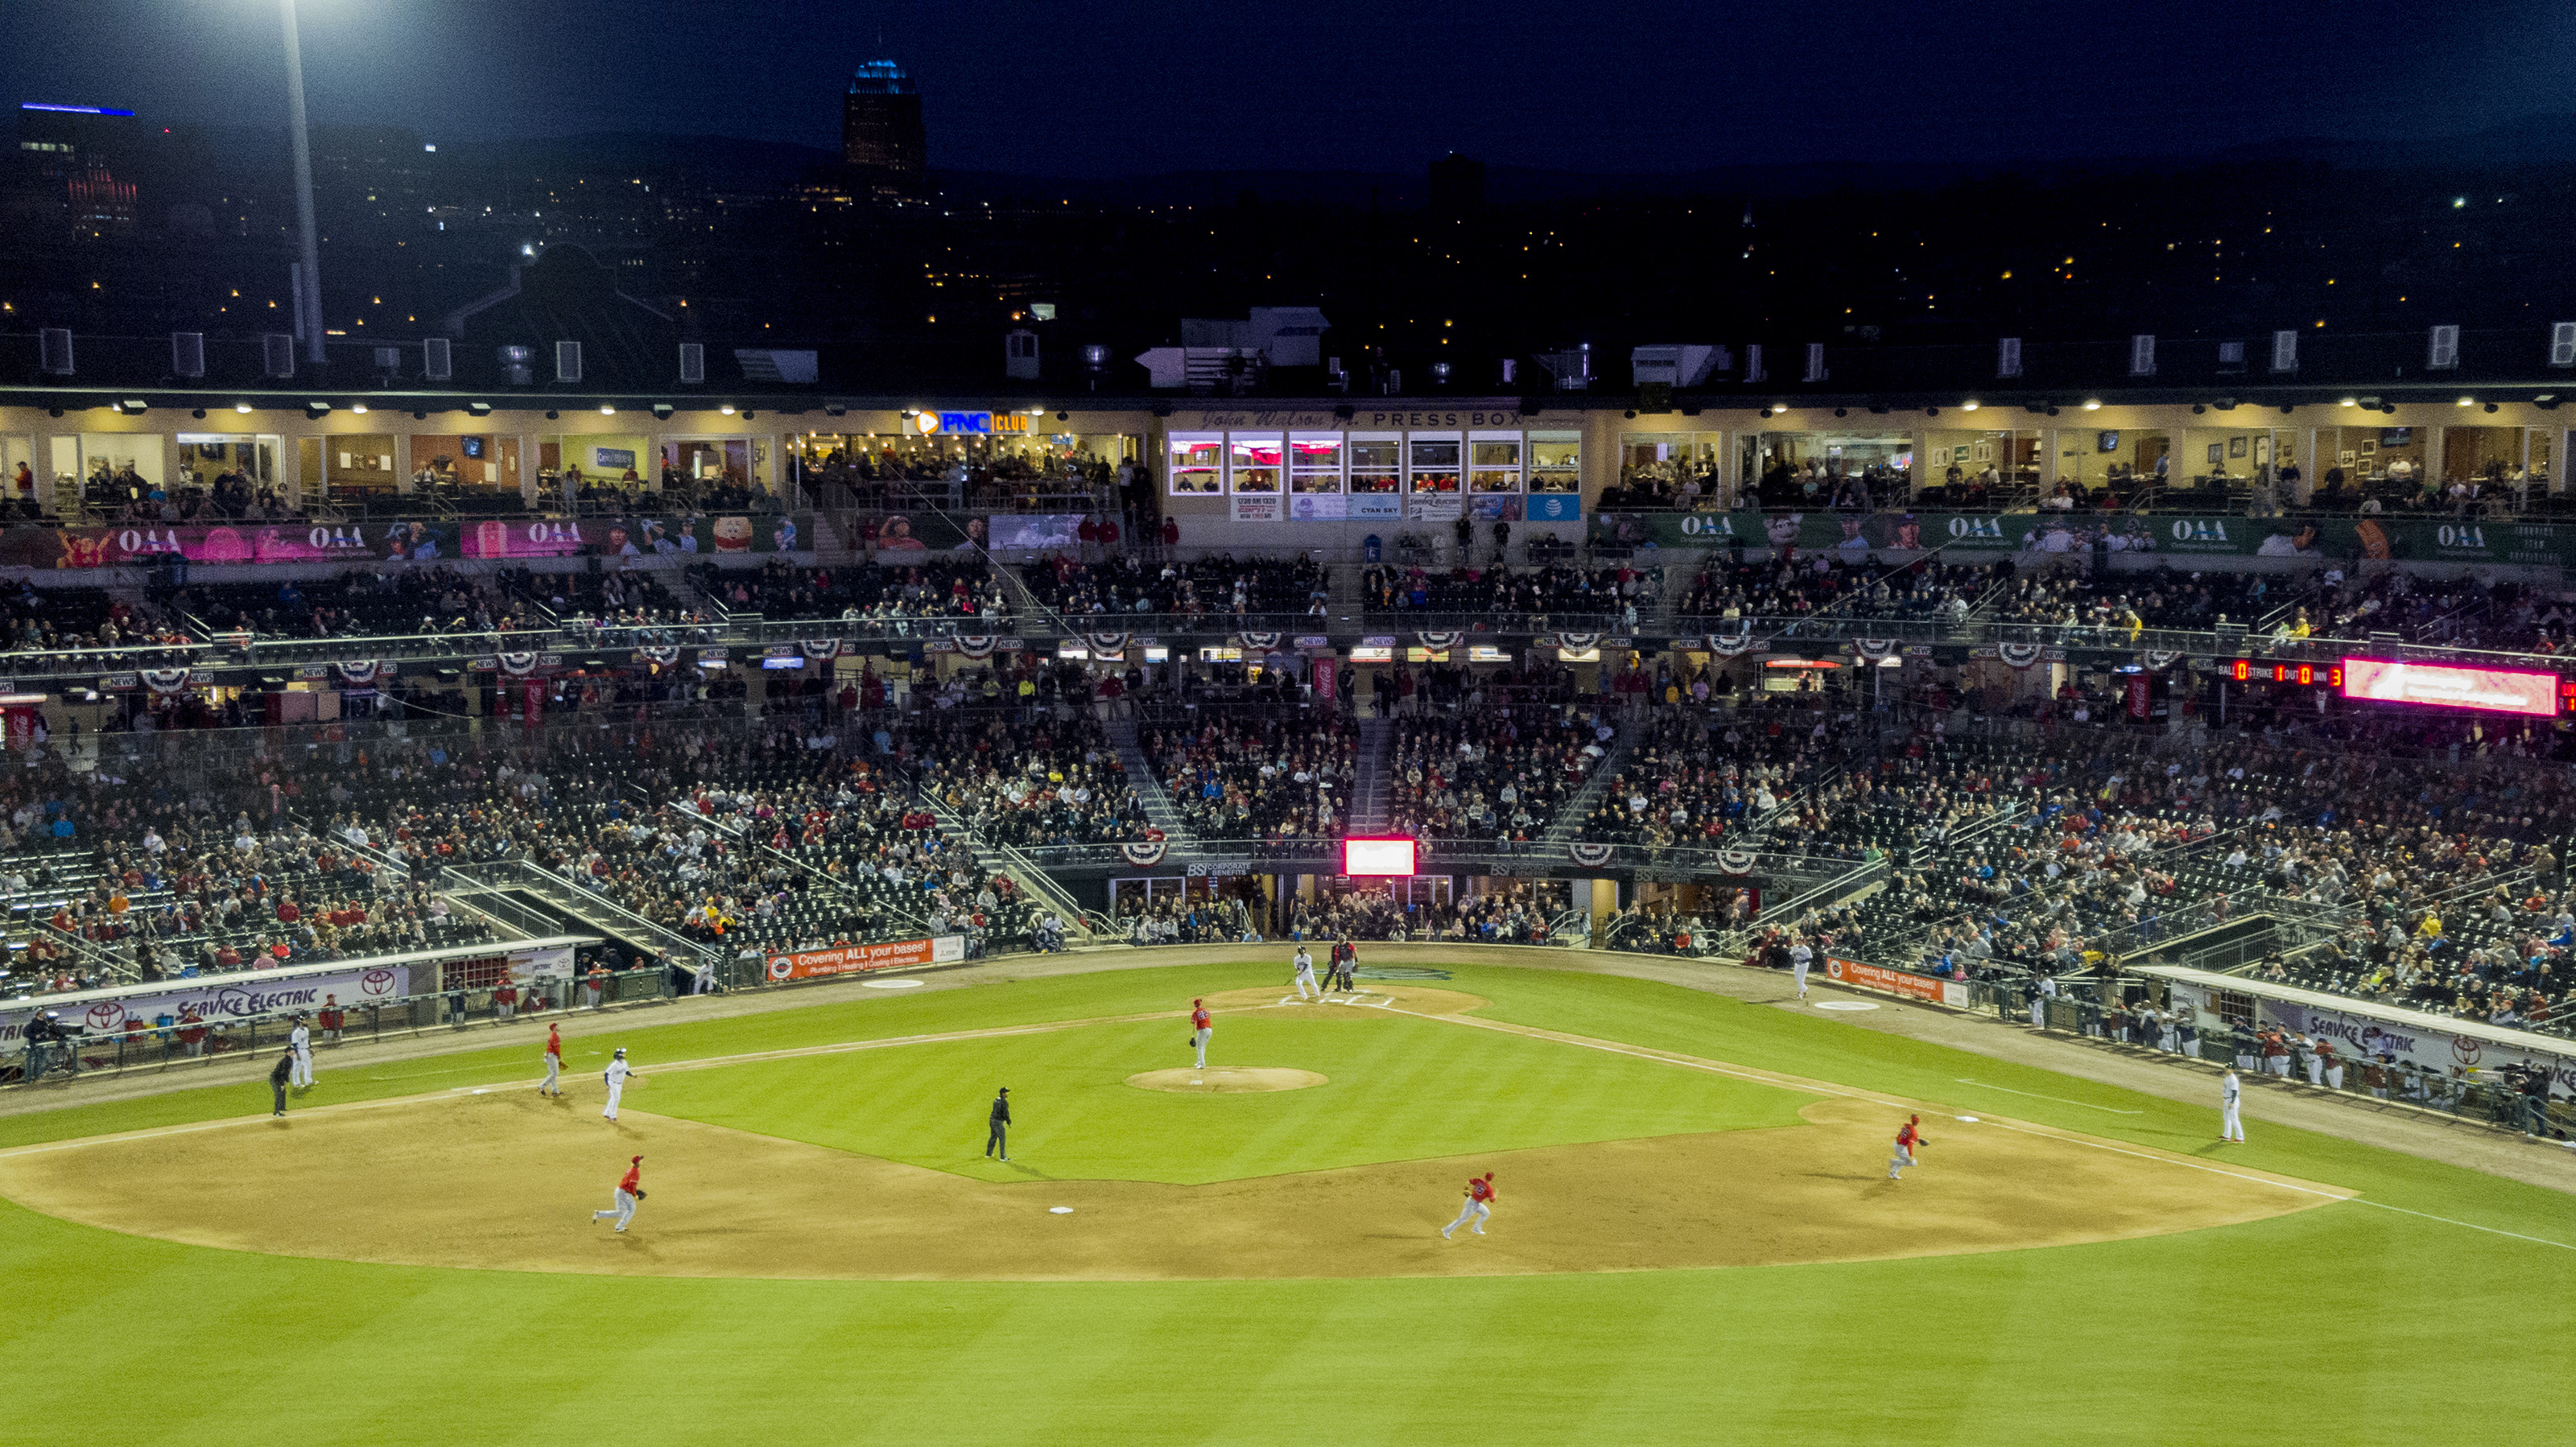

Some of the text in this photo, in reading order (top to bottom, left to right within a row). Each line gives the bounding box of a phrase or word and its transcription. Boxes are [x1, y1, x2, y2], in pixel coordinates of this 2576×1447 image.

[941, 413, 1027, 432] PNC CLUB
[1200, 410, 1245, 430] John
[1373, 413, 1521, 426] PRESS BOX
[529, 522, 582, 542] OAA
[1681, 517, 1734, 535] OAA
[1949, 517, 2003, 537] OAA
[2173, 520, 2227, 540] OAA
[119, 530, 181, 552] OAA
[309, 527, 365, 548] OAA
[2438, 526, 2485, 547] OAA
[1003, 640, 1024, 649] NEWS
[1305, 637, 1327, 645] NEWS
[1373, 637, 1395, 645] NEWS
[1610, 638, 1631, 646] NEWS
[1678, 640, 1699, 648] NEWS
[708, 649, 729, 658] NEWS
[772, 646, 793, 655] NEWS
[1912, 646, 1932, 654] NEWS
[1978, 649, 1998, 657] NEWS
[2045, 651, 2066, 660] NEWS
[476, 659, 497, 668] NEWS
[540, 656, 561, 665] NEWS
[191, 673, 214, 682] NEWS
[303, 667, 327, 678] NEWS
[2219, 663, 2341, 686] BALL 0 STRIKE 1 OUT 0 INN 3
[111, 677, 136, 686] NEWS
[1319, 665, 1332, 698] Coca-Cola
[528, 685, 542, 721] Coca-Cola
[2132, 681, 2146, 717] Coca-Cola
[1187, 864, 1208, 876] BSI
[1208, 862, 1251, 870] CORPORATE
[1491, 863, 1509, 876] BSI
[1634, 869, 1653, 882] BSI
[1654, 870, 1695, 879] CORPORATE
[798, 950, 843, 966] Covering
[846, 946, 868, 959] ALL
[870, 946, 891, 958] your
[894, 942, 926, 954] bases!
[810, 956, 919, 975] Plumbing Heating Cooling Electrical
[1851, 963, 1880, 980] Covering
[1882, 970, 1896, 982] ALL
[1897, 975, 1913, 985] your
[1913, 975, 1936, 990] bases!
[175, 988, 317, 1020] SERVICE ELECTRIC
[2310, 1016, 2359, 1041] SERVICE
